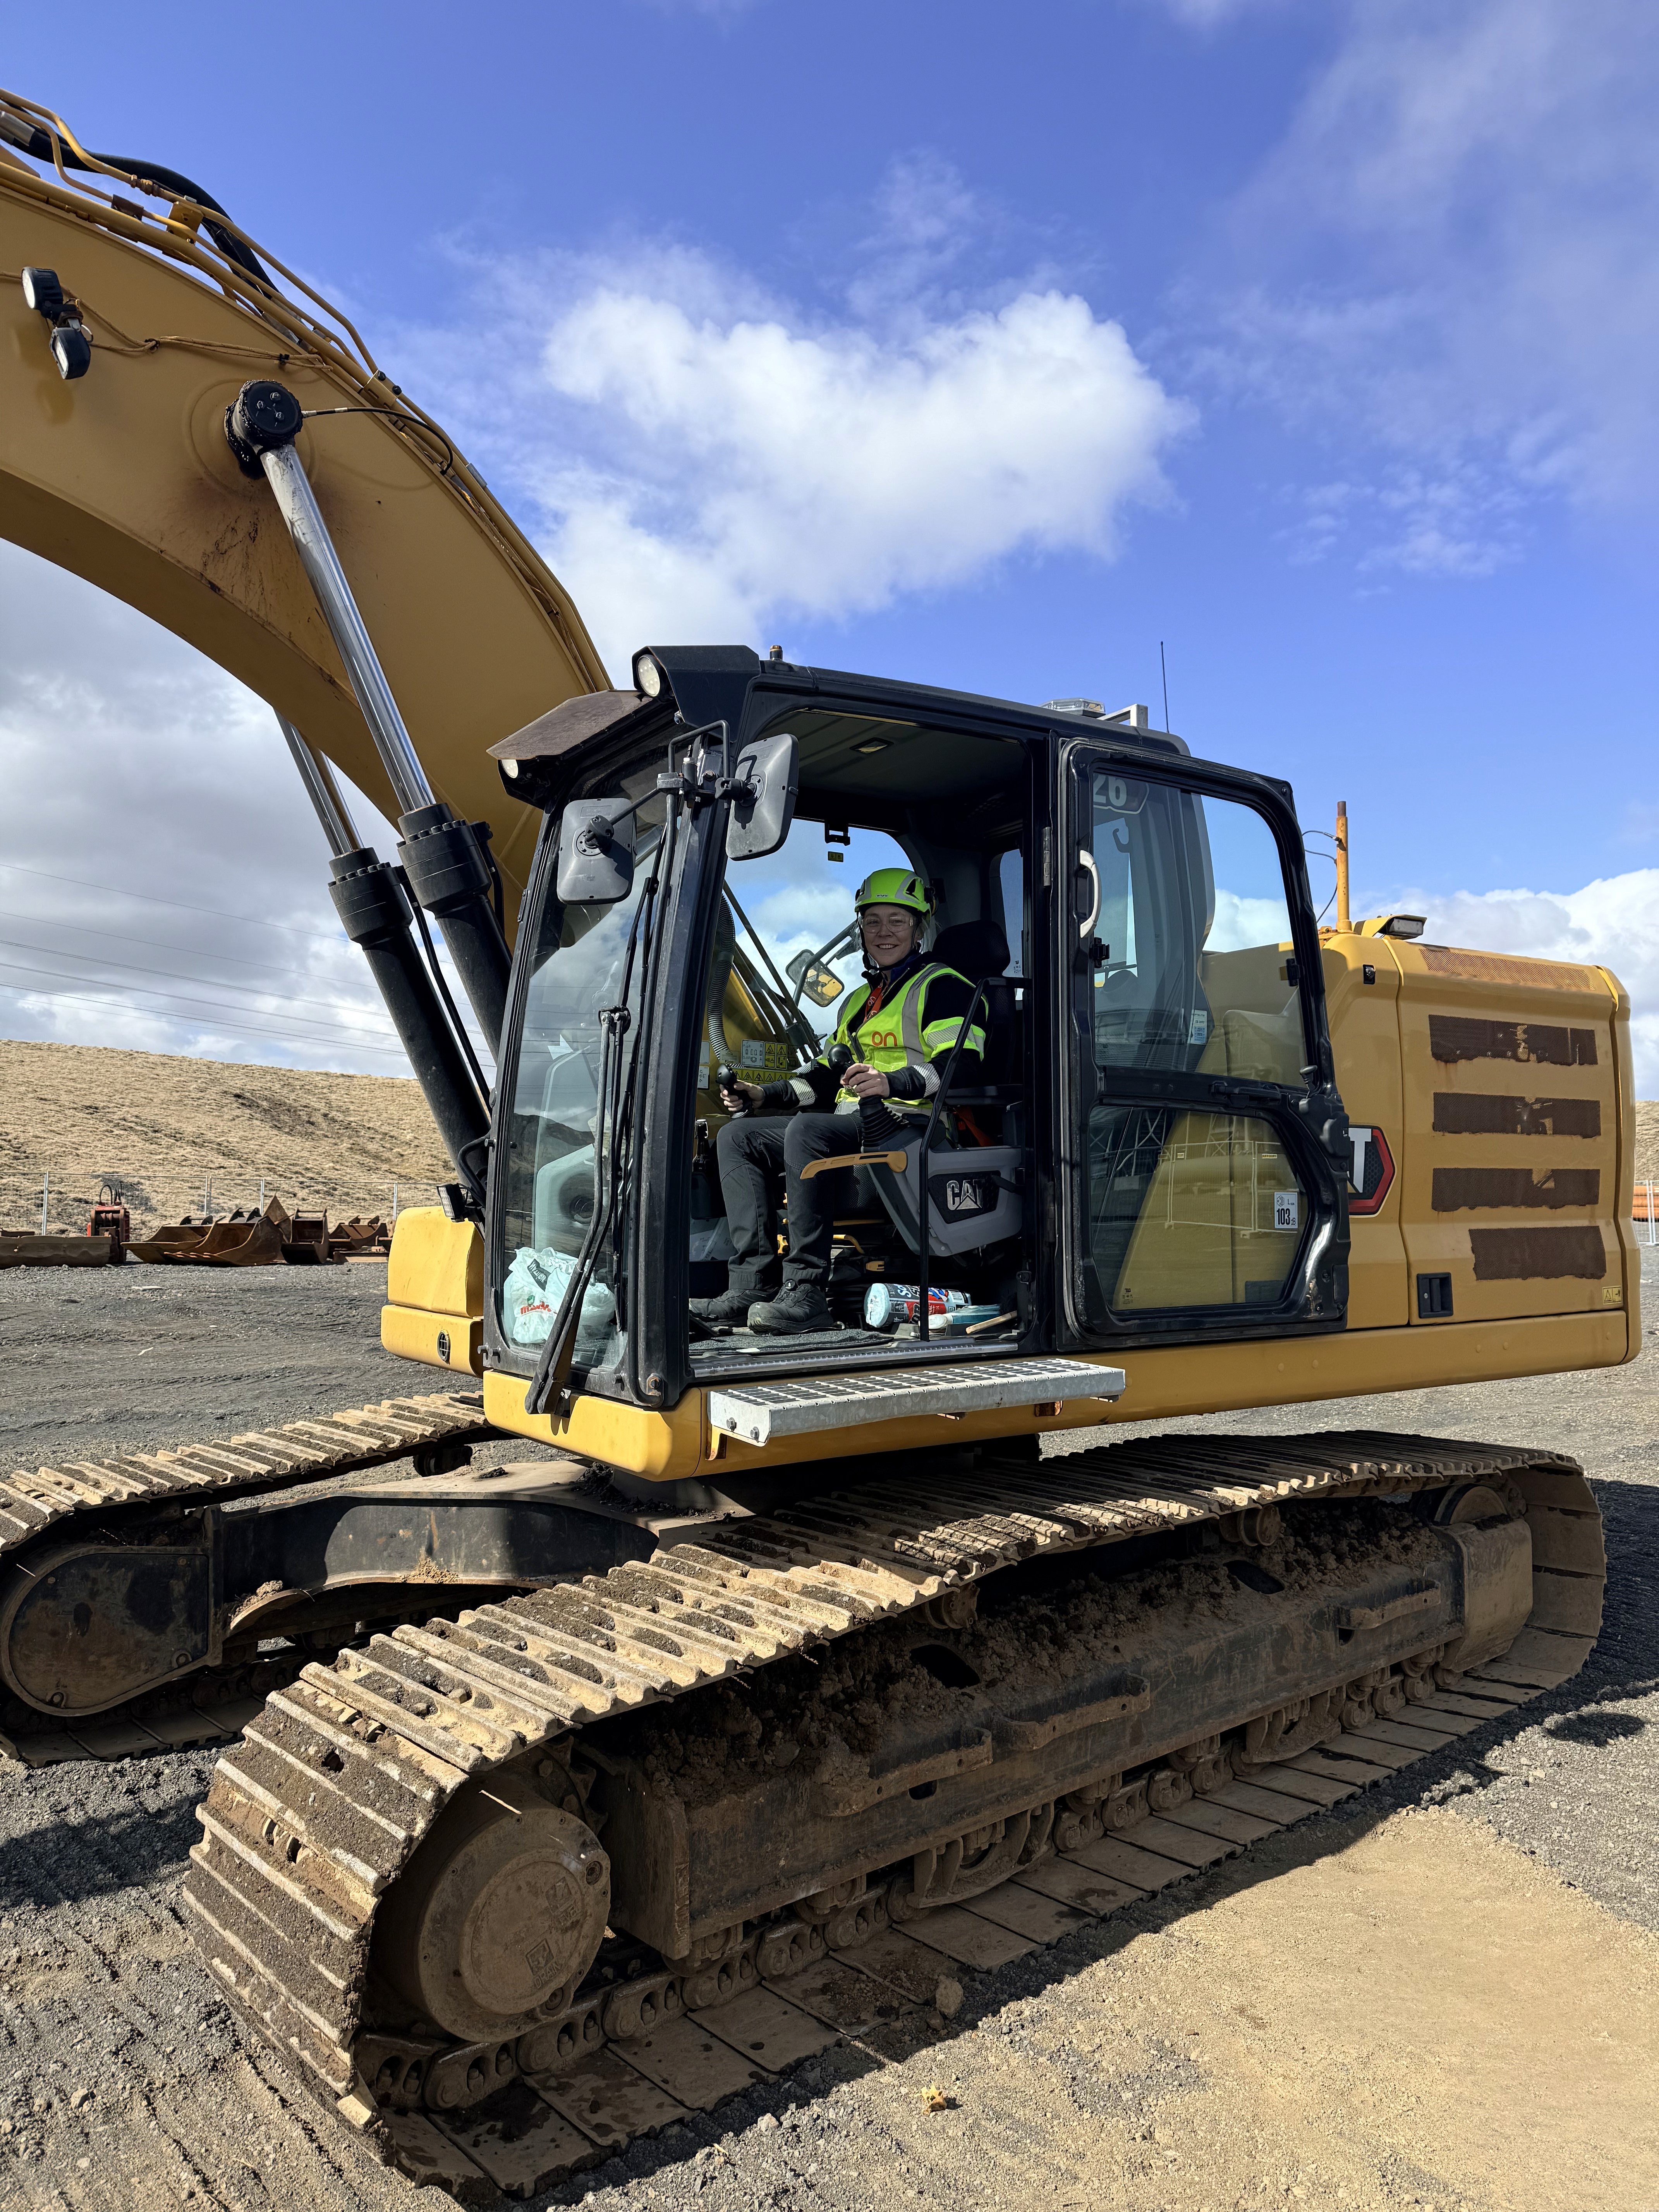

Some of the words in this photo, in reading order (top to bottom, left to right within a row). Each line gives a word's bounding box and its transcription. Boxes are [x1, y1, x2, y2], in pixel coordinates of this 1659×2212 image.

[872, 1031, 898, 1047] on
[947, 1179, 985, 1211] CAT
[1277, 1208, 1290, 1225] 103
[533, 1959, 562, 1989] DRAIN
